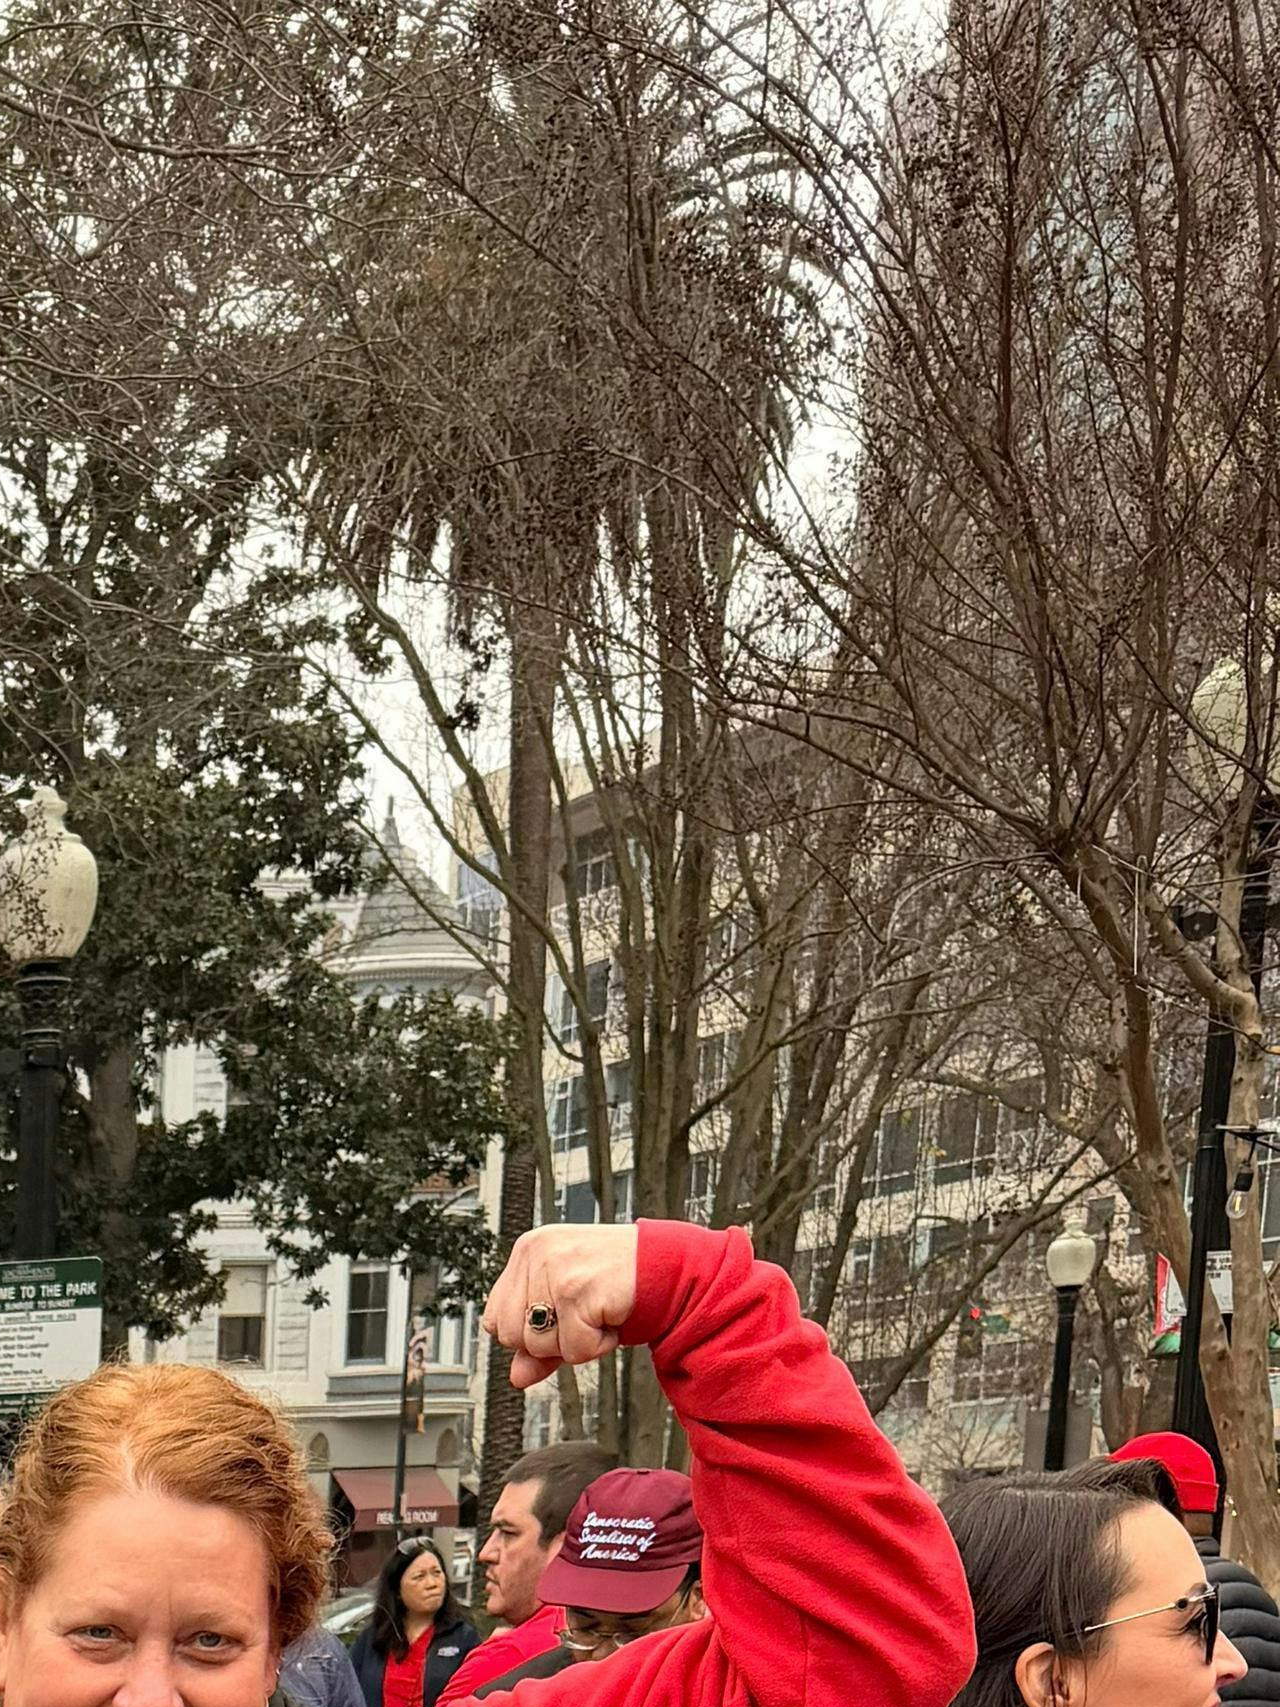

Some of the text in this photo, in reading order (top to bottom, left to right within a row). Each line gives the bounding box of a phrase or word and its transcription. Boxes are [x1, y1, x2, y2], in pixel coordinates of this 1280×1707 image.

[20, 1285, 35, 1299] TO
[40, 1283, 62, 1298] THE
[66, 1281, 97, 1296] PARK
[583, 1511, 656, 1529] Democratic
[579, 1528, 657, 1552] Socialists of
[580, 1543, 640, 1562] America
